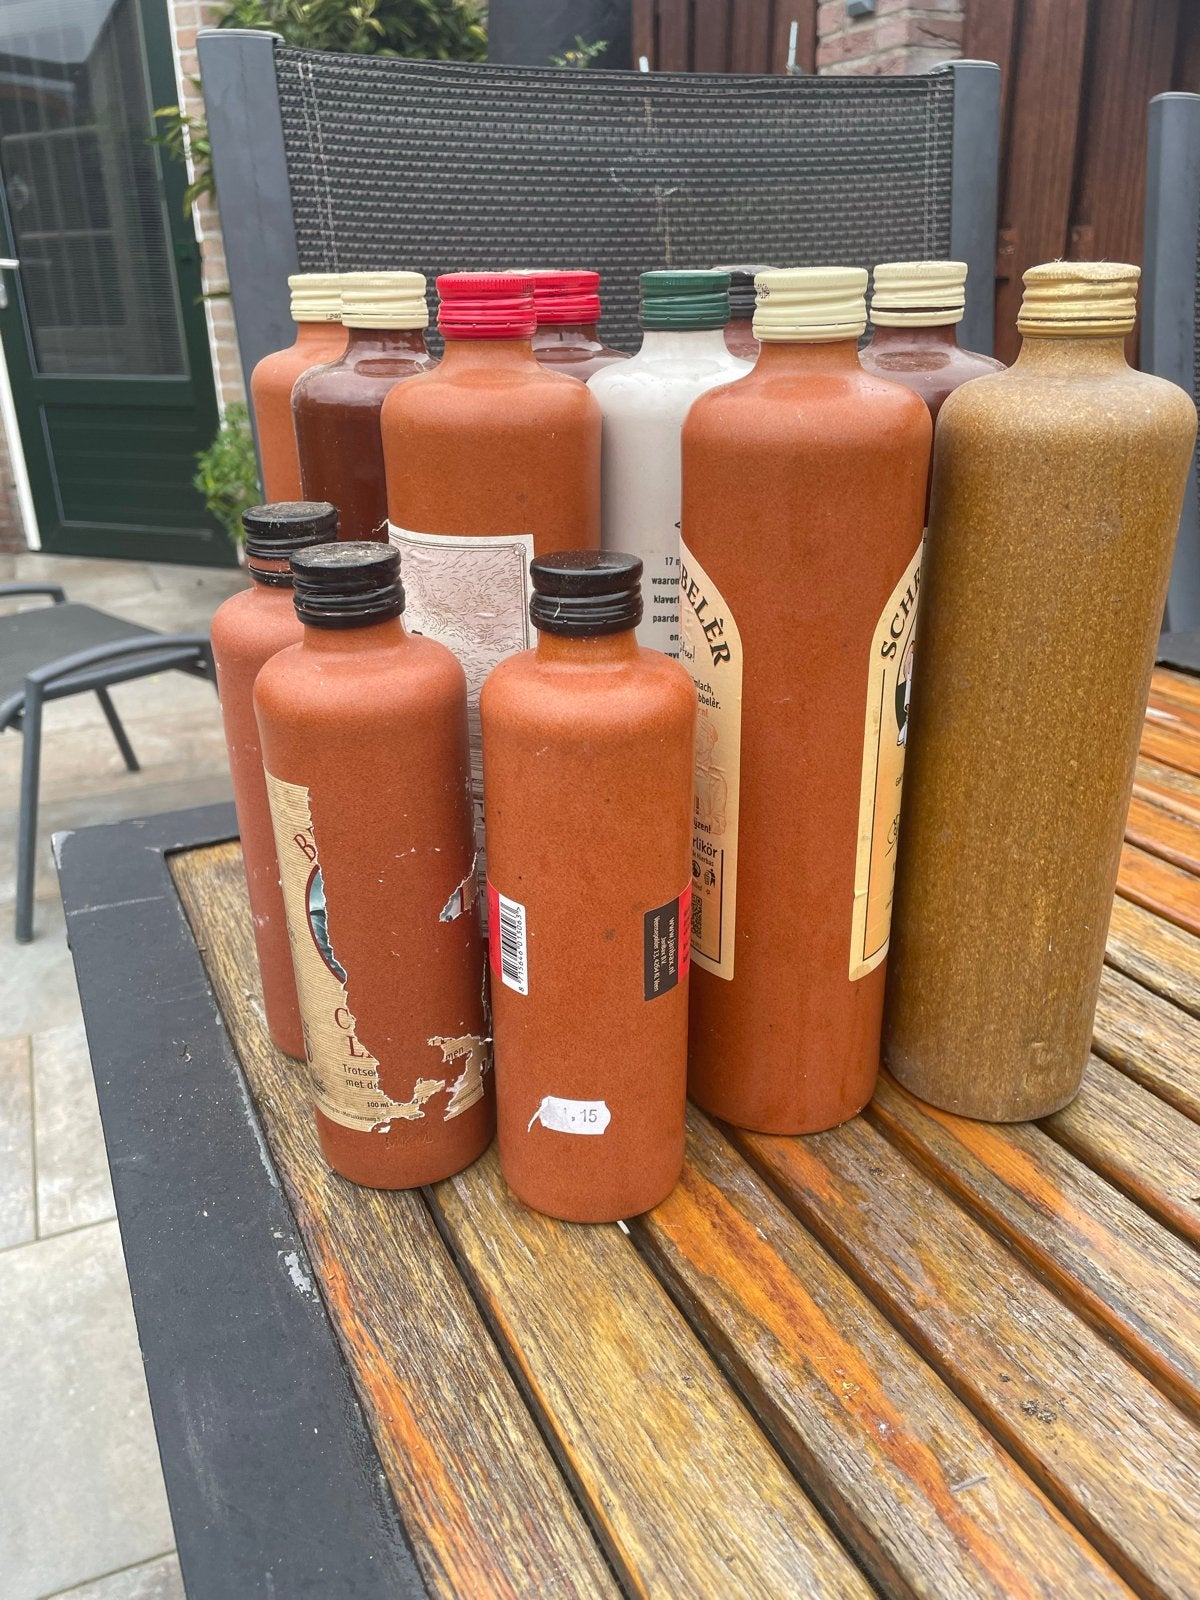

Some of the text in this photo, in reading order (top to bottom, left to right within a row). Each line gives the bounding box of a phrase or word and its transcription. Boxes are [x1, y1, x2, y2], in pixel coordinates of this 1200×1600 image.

[665, 557, 673, 566] 17
[345, 1079, 365, 1090] met
[366, 1101, 379, 1109] 100
